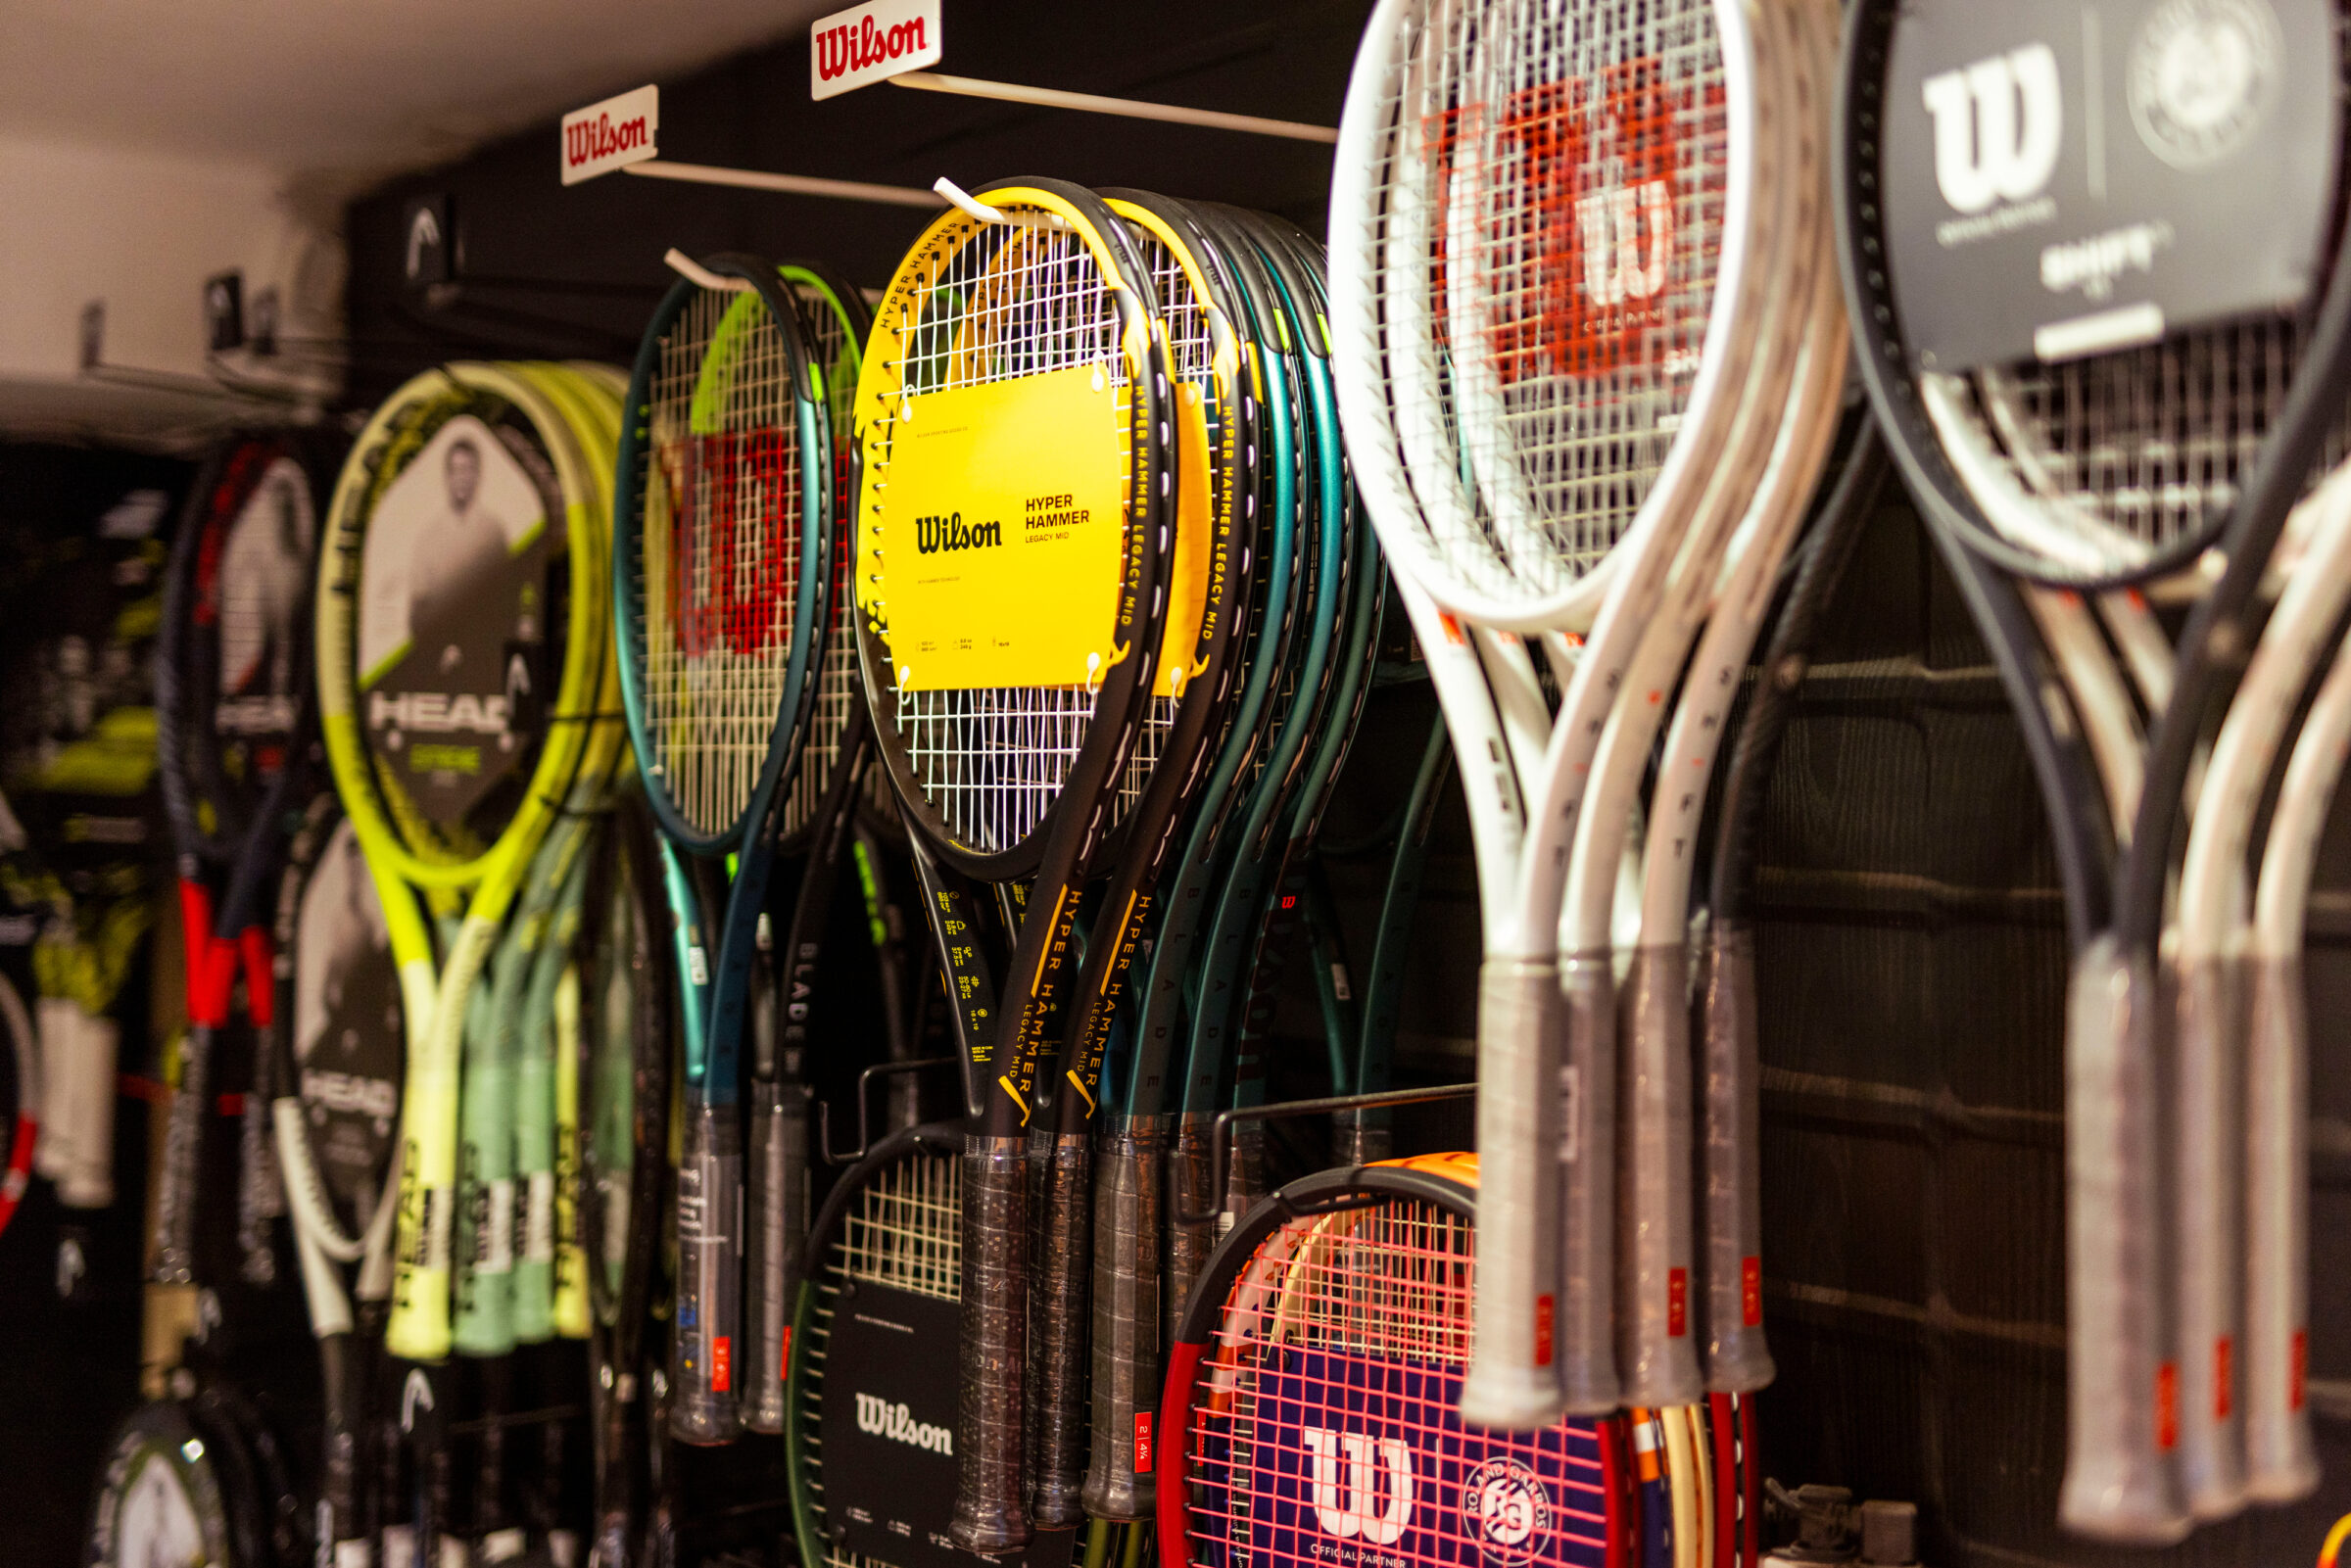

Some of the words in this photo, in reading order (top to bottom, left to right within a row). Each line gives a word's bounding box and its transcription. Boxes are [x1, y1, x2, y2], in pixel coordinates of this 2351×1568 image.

[816, 15, 927, 81] Wilson
[566, 112, 648, 166] Wilson
[880, 275, 911, 328] HYPER
[909, 222, 960, 268] HAMMER
[1135, 386, 1149, 440] HYPER
[1223, 405, 1236, 459] HYPER
[1026, 494, 1073, 512] HYPER
[1135, 447, 1149, 518] HAMMER
[1219, 466, 1234, 537] HAMMER
[915, 511, 1002, 554] Wilson
[1025, 533, 1054, 544] LEGACY
[1055, 531, 1070, 540] MID
[1026, 509, 1090, 530] HAMMER
[1128, 524, 1145, 591] LEGACY
[1211, 543, 1228, 606] LEGACY
[1120, 595, 1136, 627] MID
[1202, 611, 1218, 641] MID
[1048, 889, 1083, 970] HYPER
[1118, 895, 1152, 970] HYPER
[1146, 886, 1201, 1087] BLADE
[1199, 887, 1252, 1086] BLADE
[1016, 1004, 1033, 1050] LEGACY
[1019, 983, 1055, 1093] HAMMER
[1083, 1002, 1102, 1045] LEGACY
[1085, 983, 1123, 1086] HAMMER
[1009, 1056, 1021, 1077] MID
[1077, 1051, 1088, 1072] MID
[855, 1392, 953, 1456] Wilson
[1310, 1544, 1360, 1562] OFFICIAL
[1360, 1551, 1407, 1568] PARTNER
